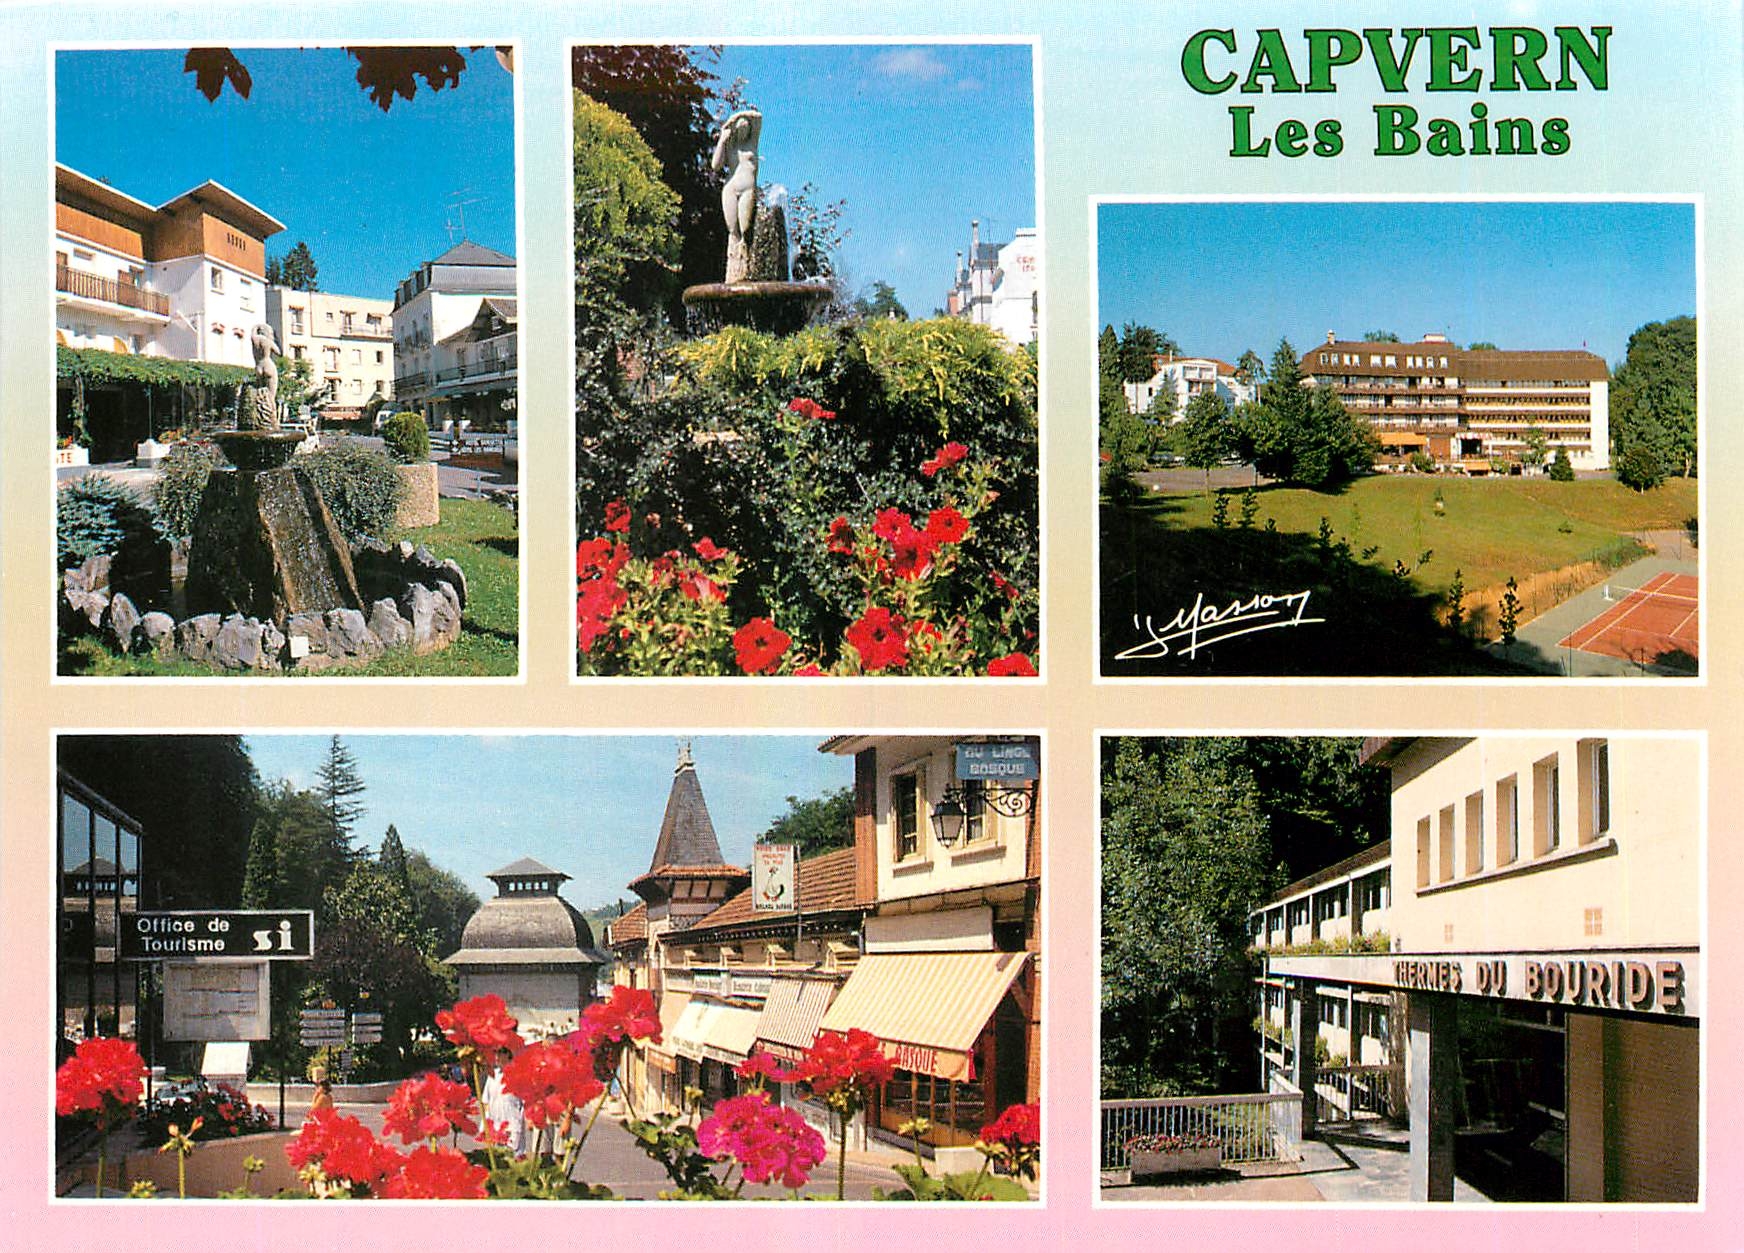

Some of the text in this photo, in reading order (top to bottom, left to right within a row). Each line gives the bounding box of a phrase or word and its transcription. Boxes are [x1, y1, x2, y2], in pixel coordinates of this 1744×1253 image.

[969, 763, 1025, 776] BASQUE
[137, 917, 196, 933] Office
[207, 917, 230, 933] de
[141, 936, 226, 952] Tourisme
[1392, 960, 1686, 1014] THERMES DU BOURIDE
[895, 1045, 937, 1073] BASQUE
